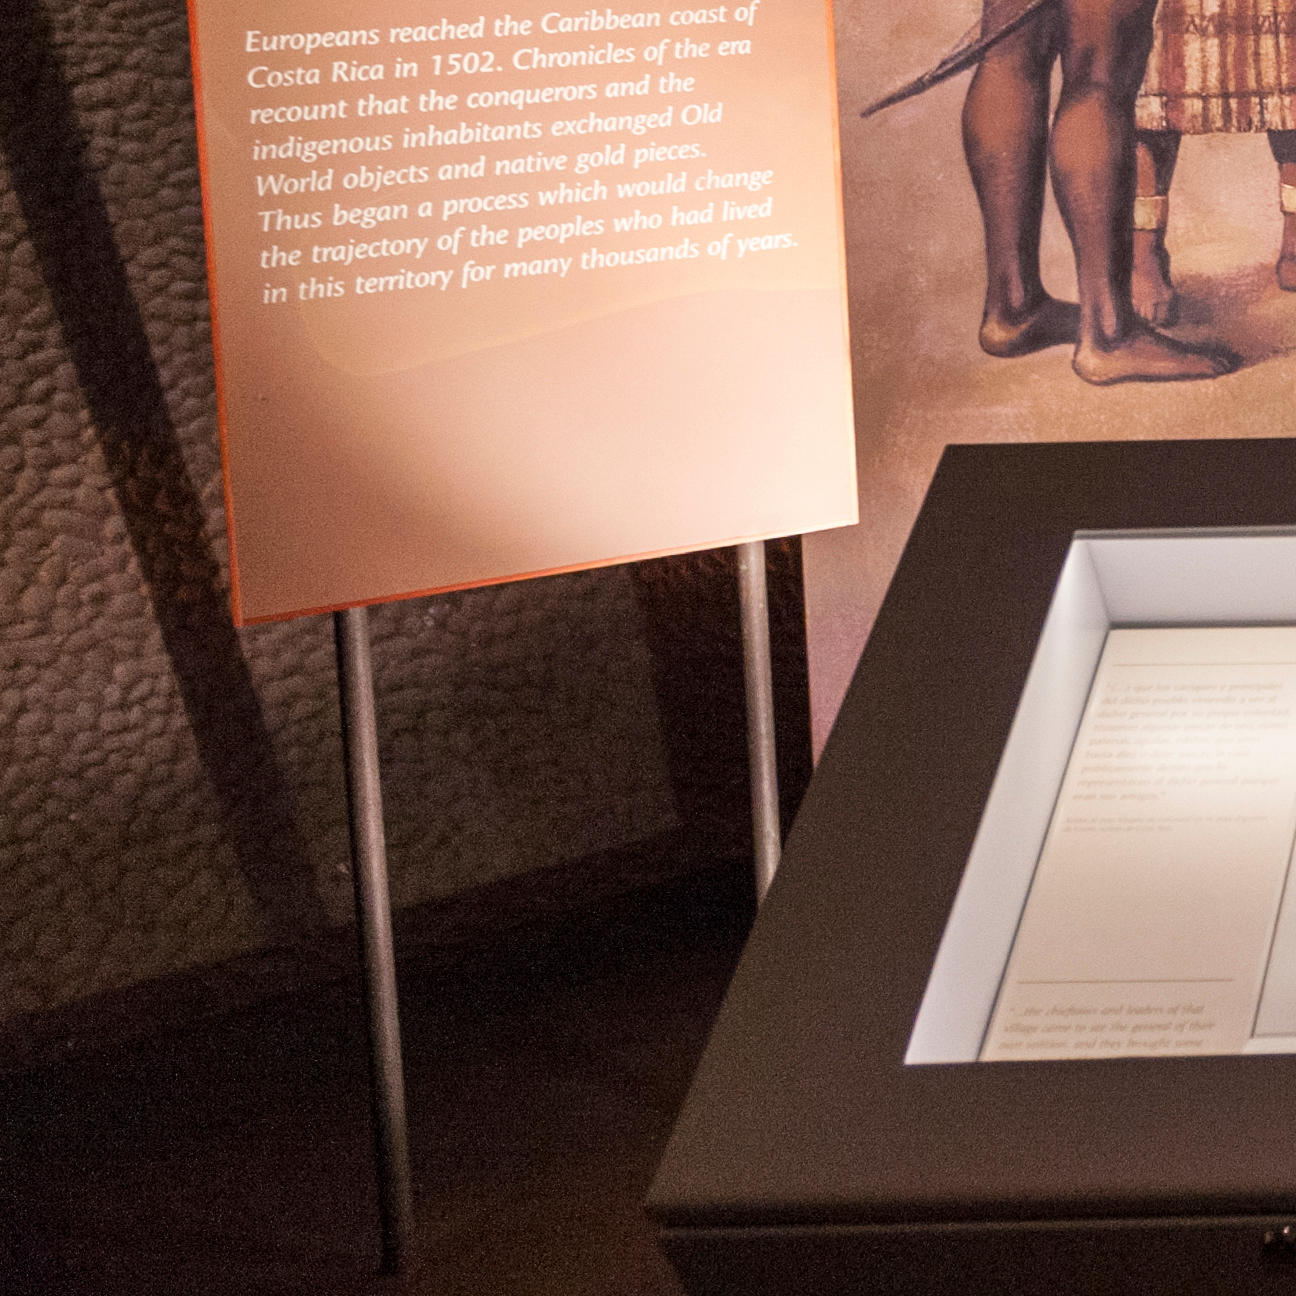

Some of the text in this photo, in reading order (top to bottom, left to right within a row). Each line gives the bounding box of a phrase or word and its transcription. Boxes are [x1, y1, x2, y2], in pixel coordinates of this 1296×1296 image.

[244, 0, 761, 55] Europeans reached the Caribbean coast of
[246, 37, 752, 89] Costa Rica in 1502. Chronicles of the era
[249, 71, 696, 125] recount that the conquerors and the
[252, 101, 723, 163] indigenous inhabitants exchanged Old
[255, 141, 707, 197] World objects and native gold pieces.
[257, 169, 774, 233] Thus began a process which would change
[259, 196, 774, 270] the trajectory of the peoples who had lived
[262, 232, 798, 305] in this territory for many thousands of years.
